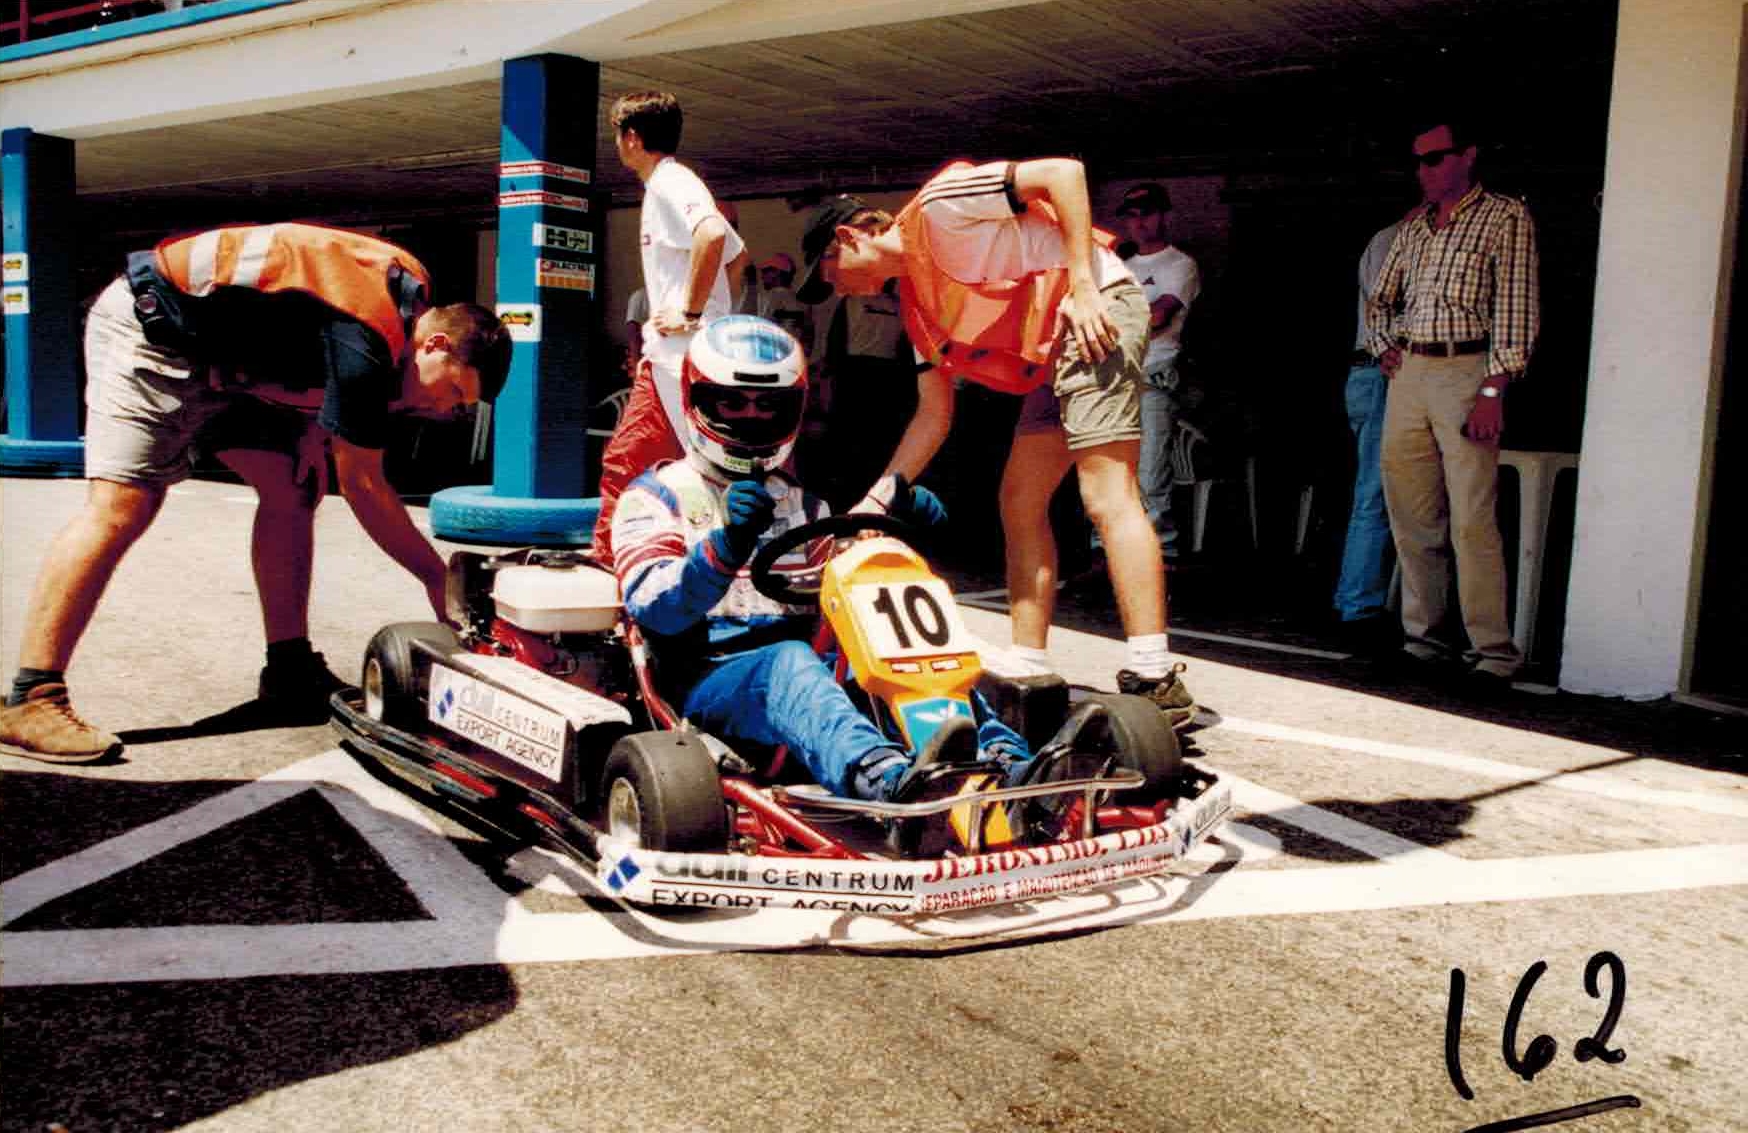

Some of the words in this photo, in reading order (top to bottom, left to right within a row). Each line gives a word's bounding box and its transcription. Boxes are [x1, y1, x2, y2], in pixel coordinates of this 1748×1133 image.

[873, 585, 950, 649] 10
[762, 868, 915, 892] CENTRUM
[652, 888, 773, 908] EXPORT
